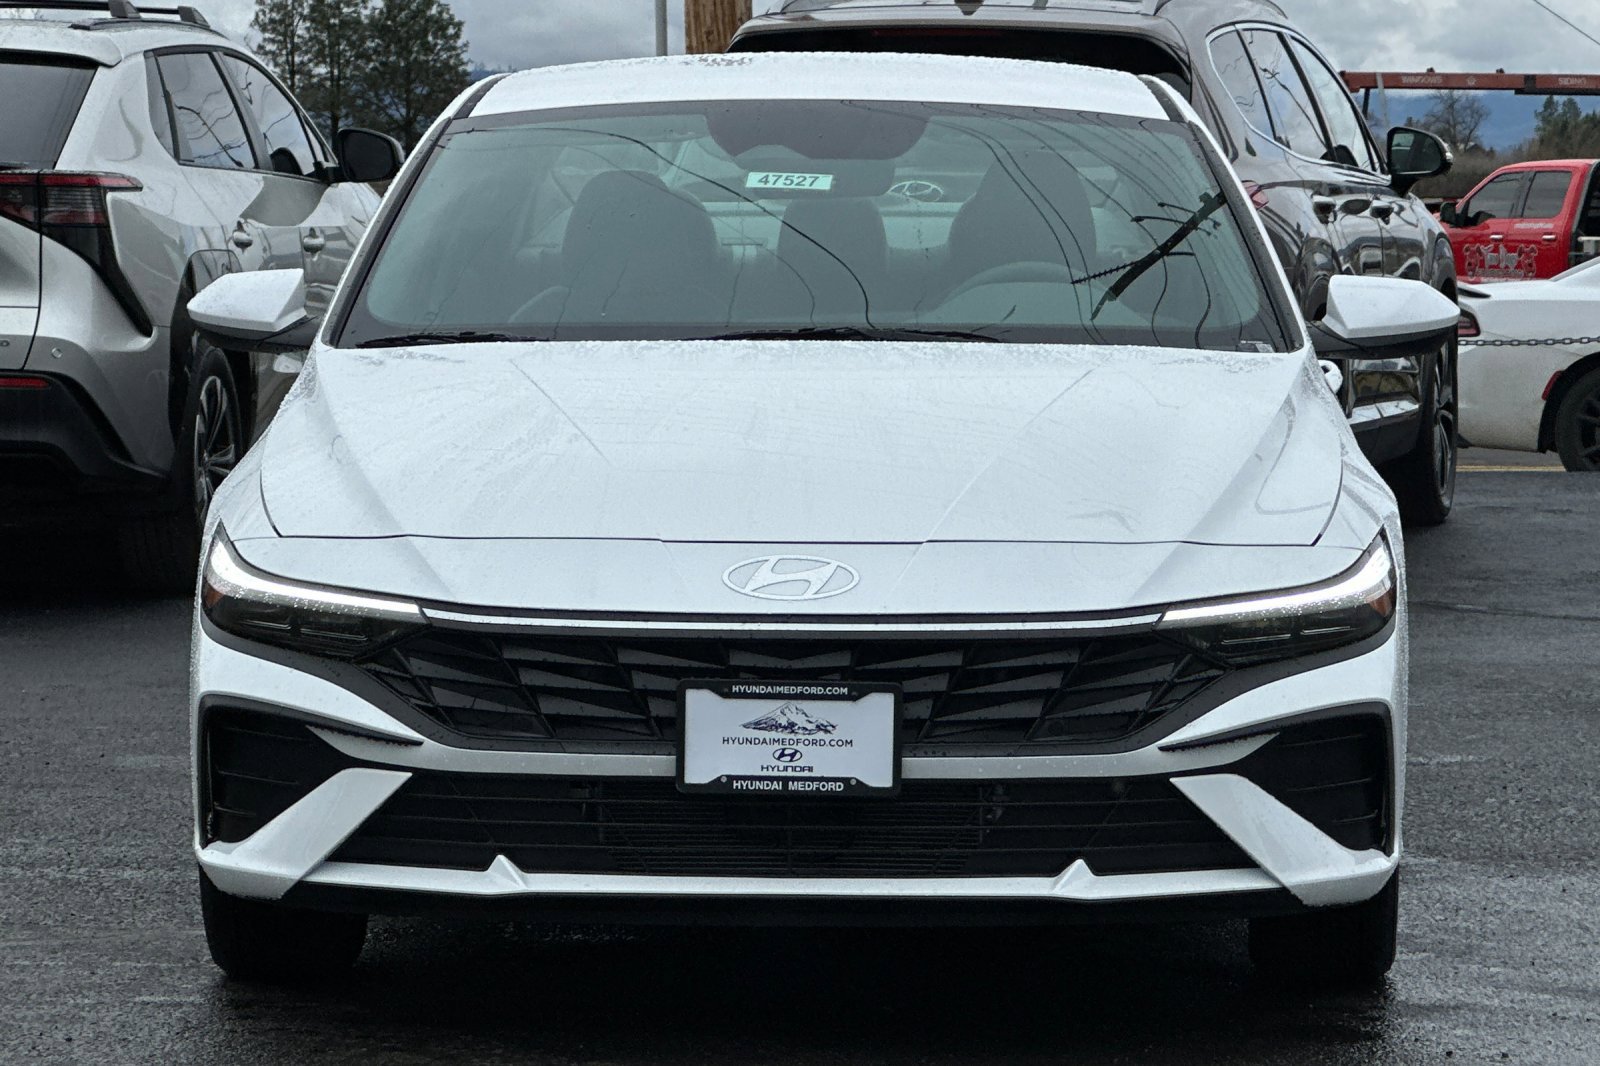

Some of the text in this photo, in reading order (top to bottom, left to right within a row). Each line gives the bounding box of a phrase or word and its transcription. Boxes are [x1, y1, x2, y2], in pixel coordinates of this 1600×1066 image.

[757, 174, 820, 187] 47527
[732, 684, 848, 695] HYUNDAIMEDFORD.COM
[722, 736, 853, 748] HYUNDAIMEDFORD.COM
[760, 764, 813, 773] HYUNDAI
[732, 780, 844, 792] HYUNDAI MEDFORD
